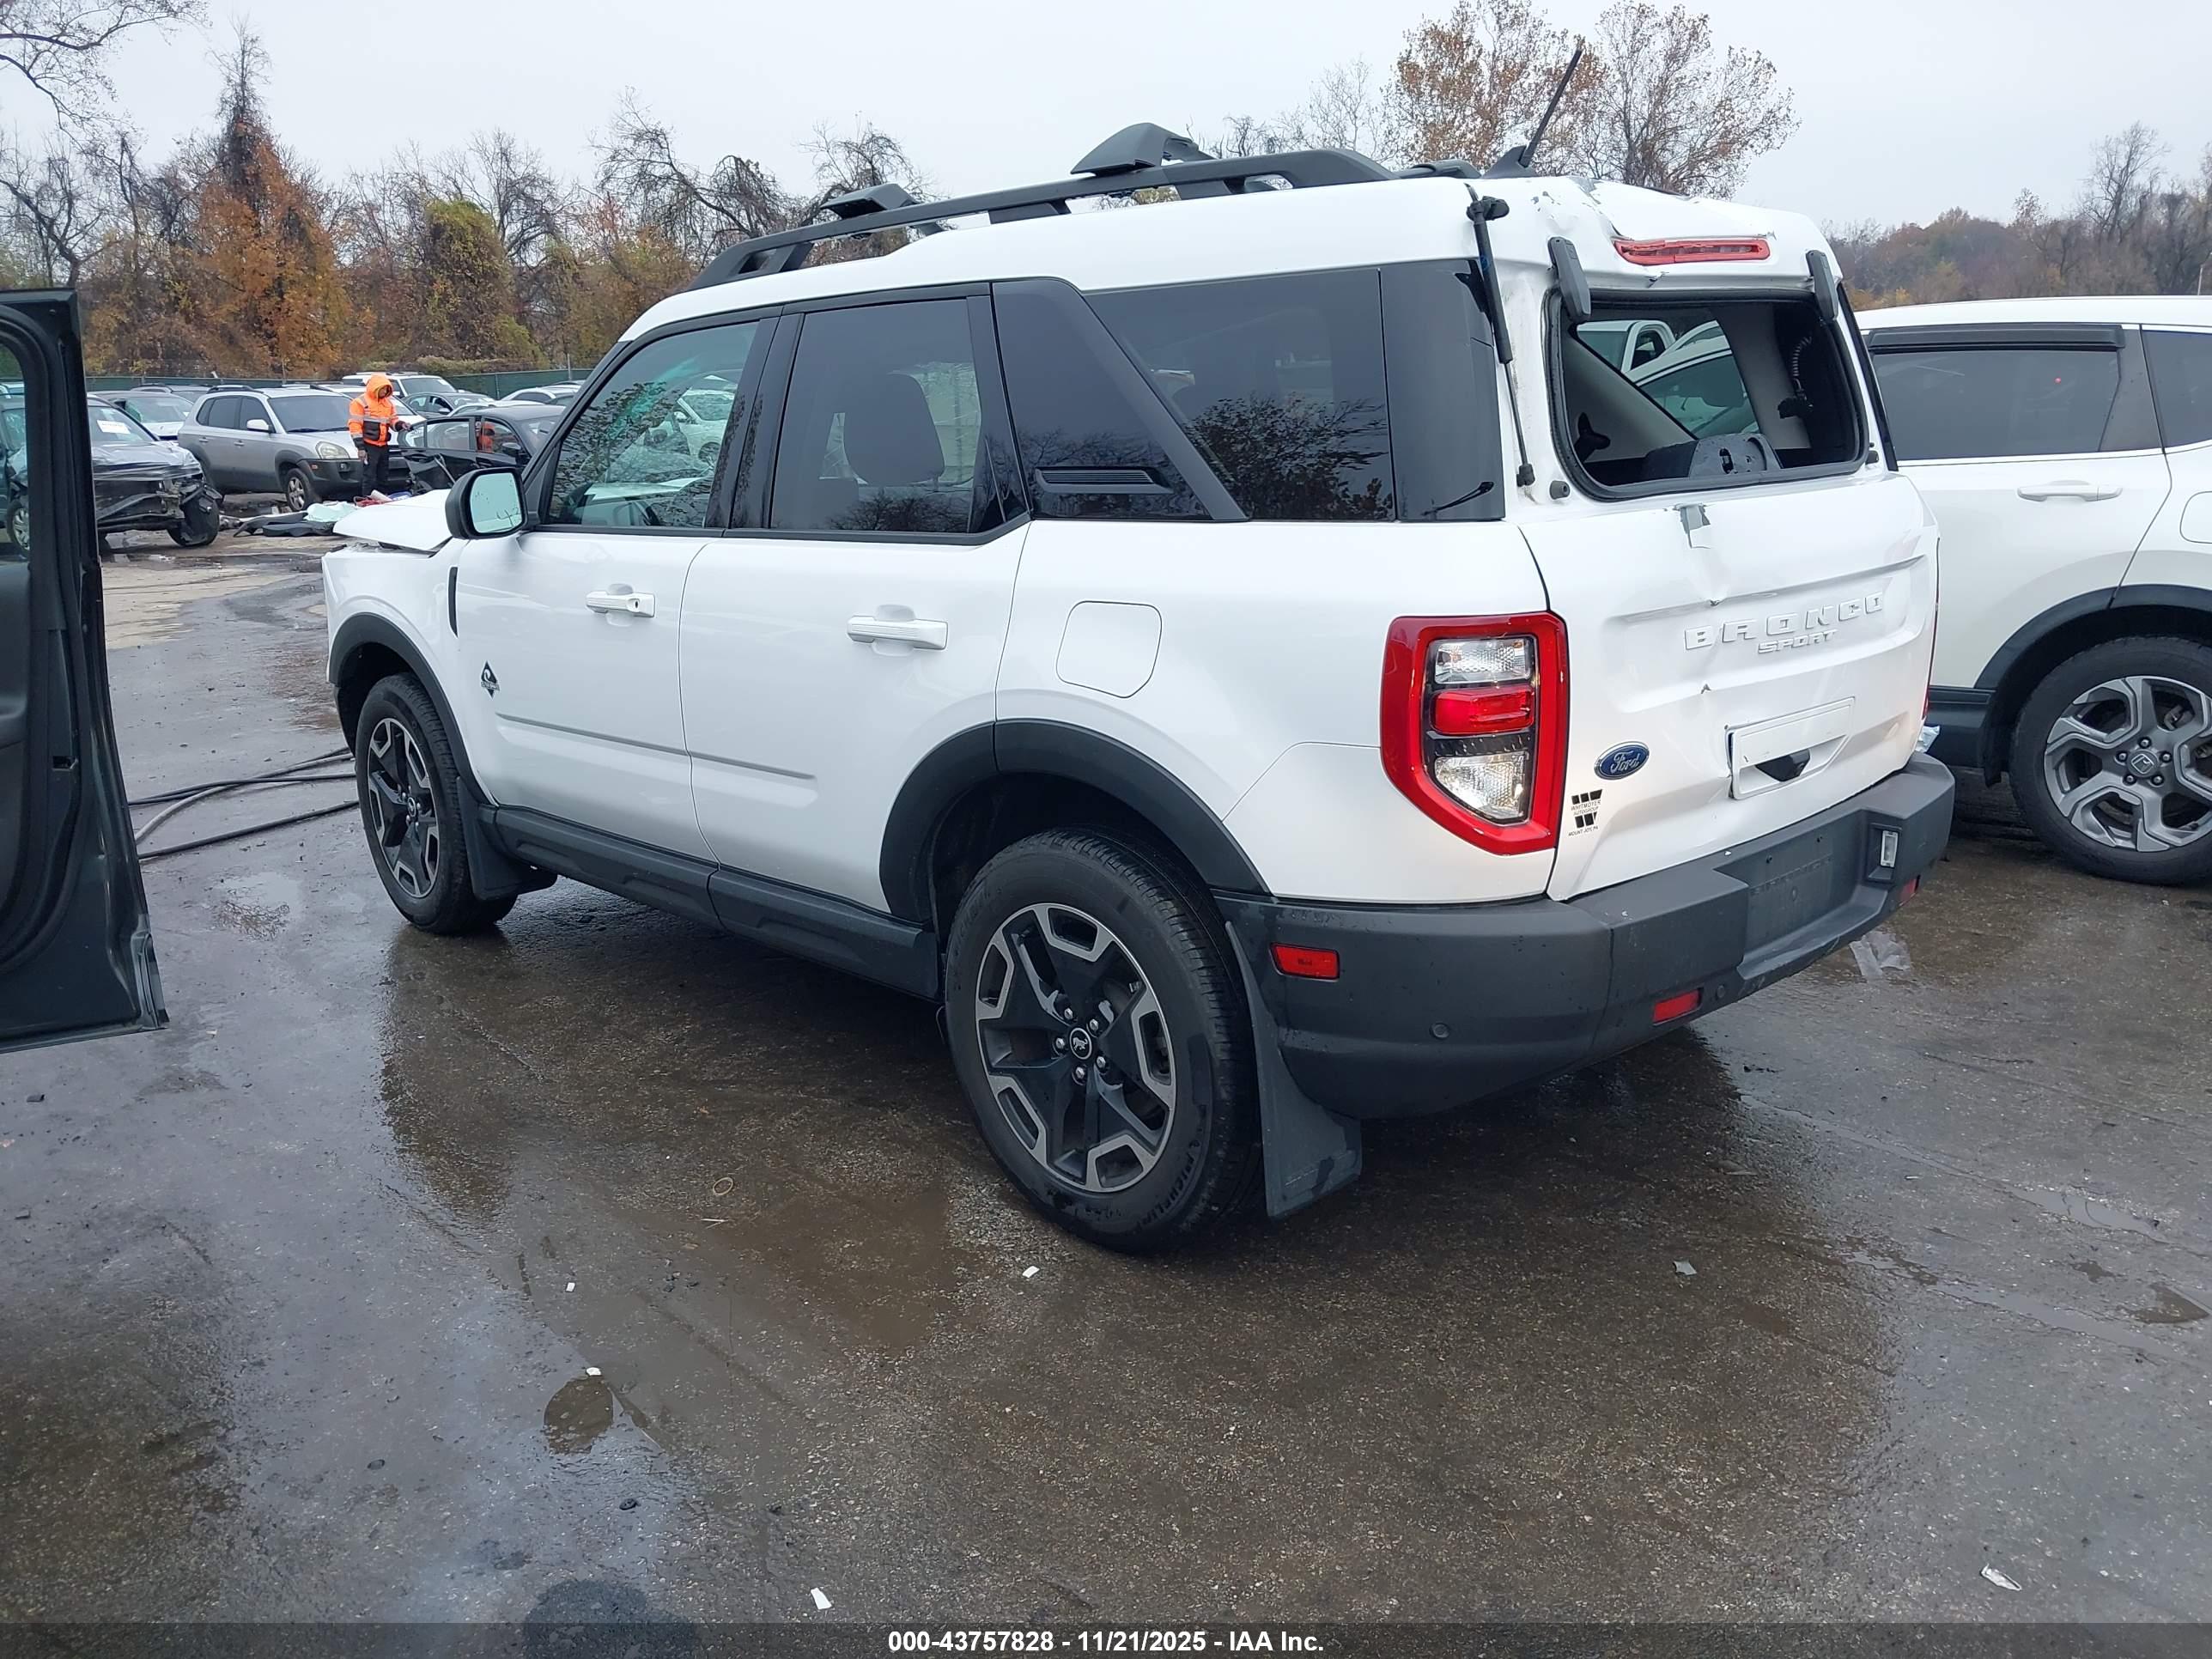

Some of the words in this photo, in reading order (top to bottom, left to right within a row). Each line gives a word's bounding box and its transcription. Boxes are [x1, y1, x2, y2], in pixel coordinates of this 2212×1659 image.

[1684, 591, 1884, 650] BRONCO
[1758, 629, 1838, 653] SPORT
[1609, 750, 1641, 774] Ford
